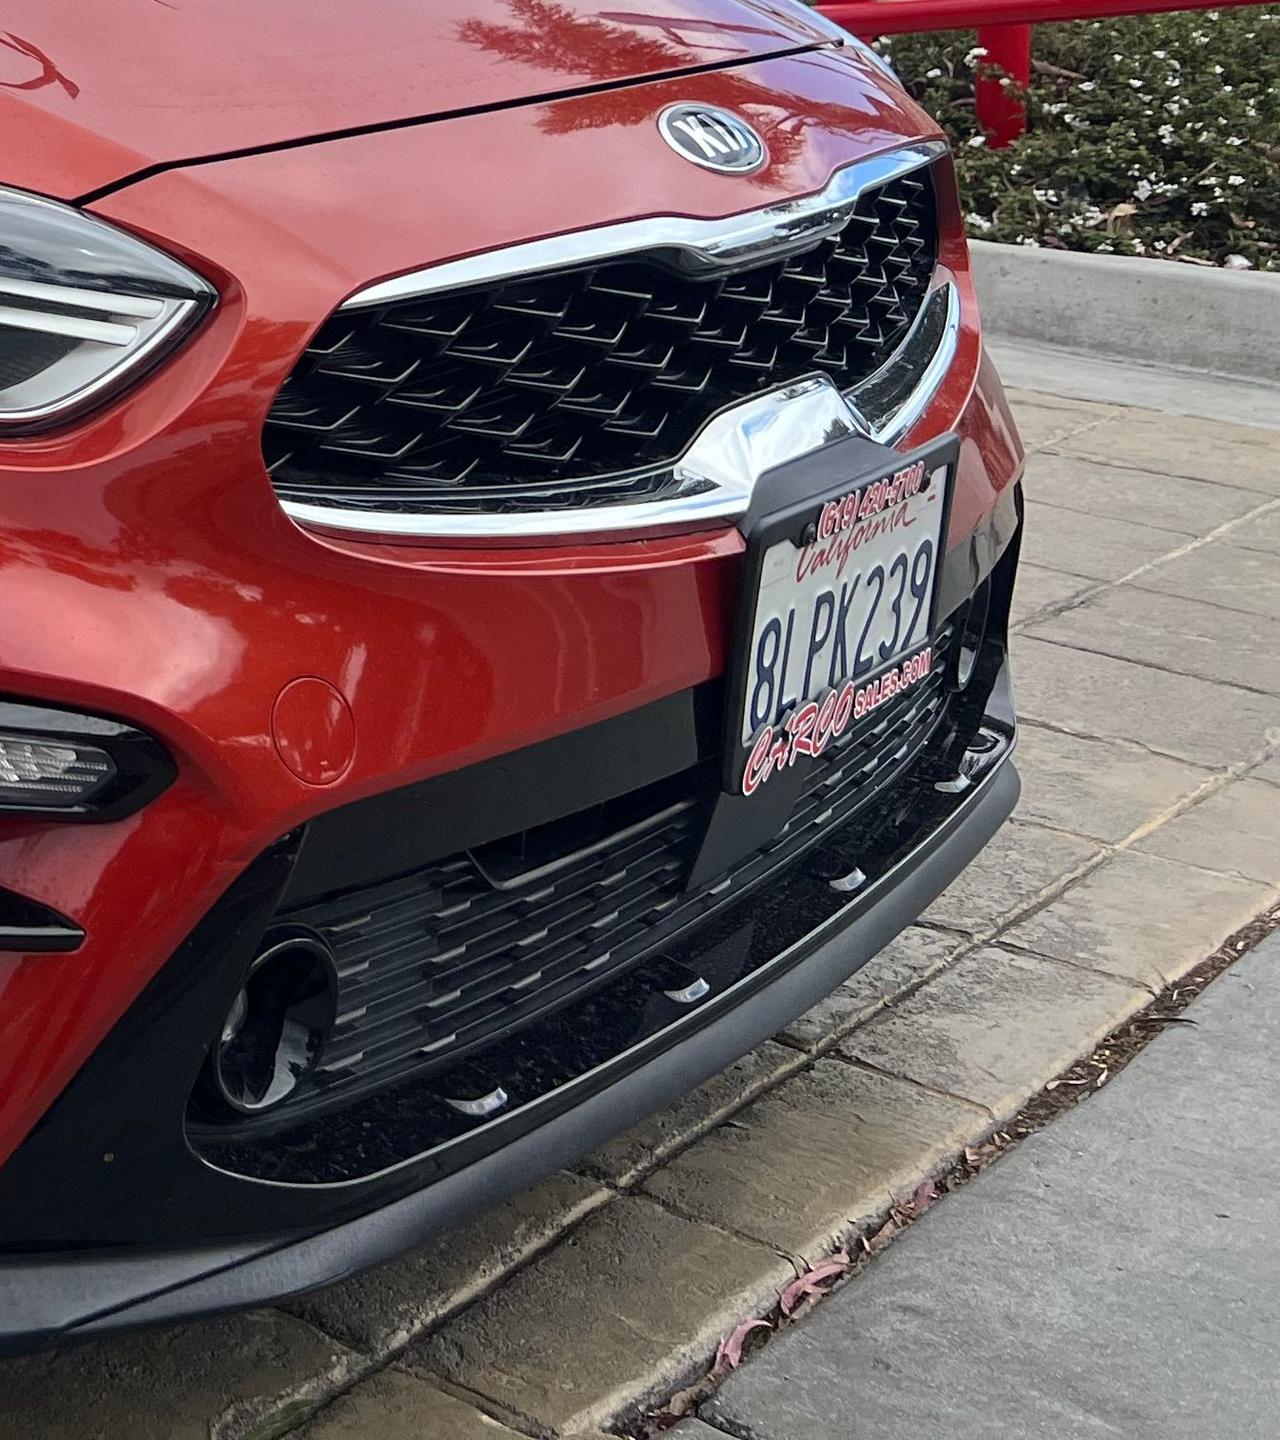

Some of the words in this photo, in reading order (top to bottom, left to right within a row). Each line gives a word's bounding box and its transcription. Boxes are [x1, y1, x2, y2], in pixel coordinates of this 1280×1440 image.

[816, 489, 862, 542] (619)
[857, 459, 926, 520] 420-5700
[795, 502, 917, 583] California
[750, 538, 934, 732] 8LPK239
[853, 646, 933, 720] SALES.COM
